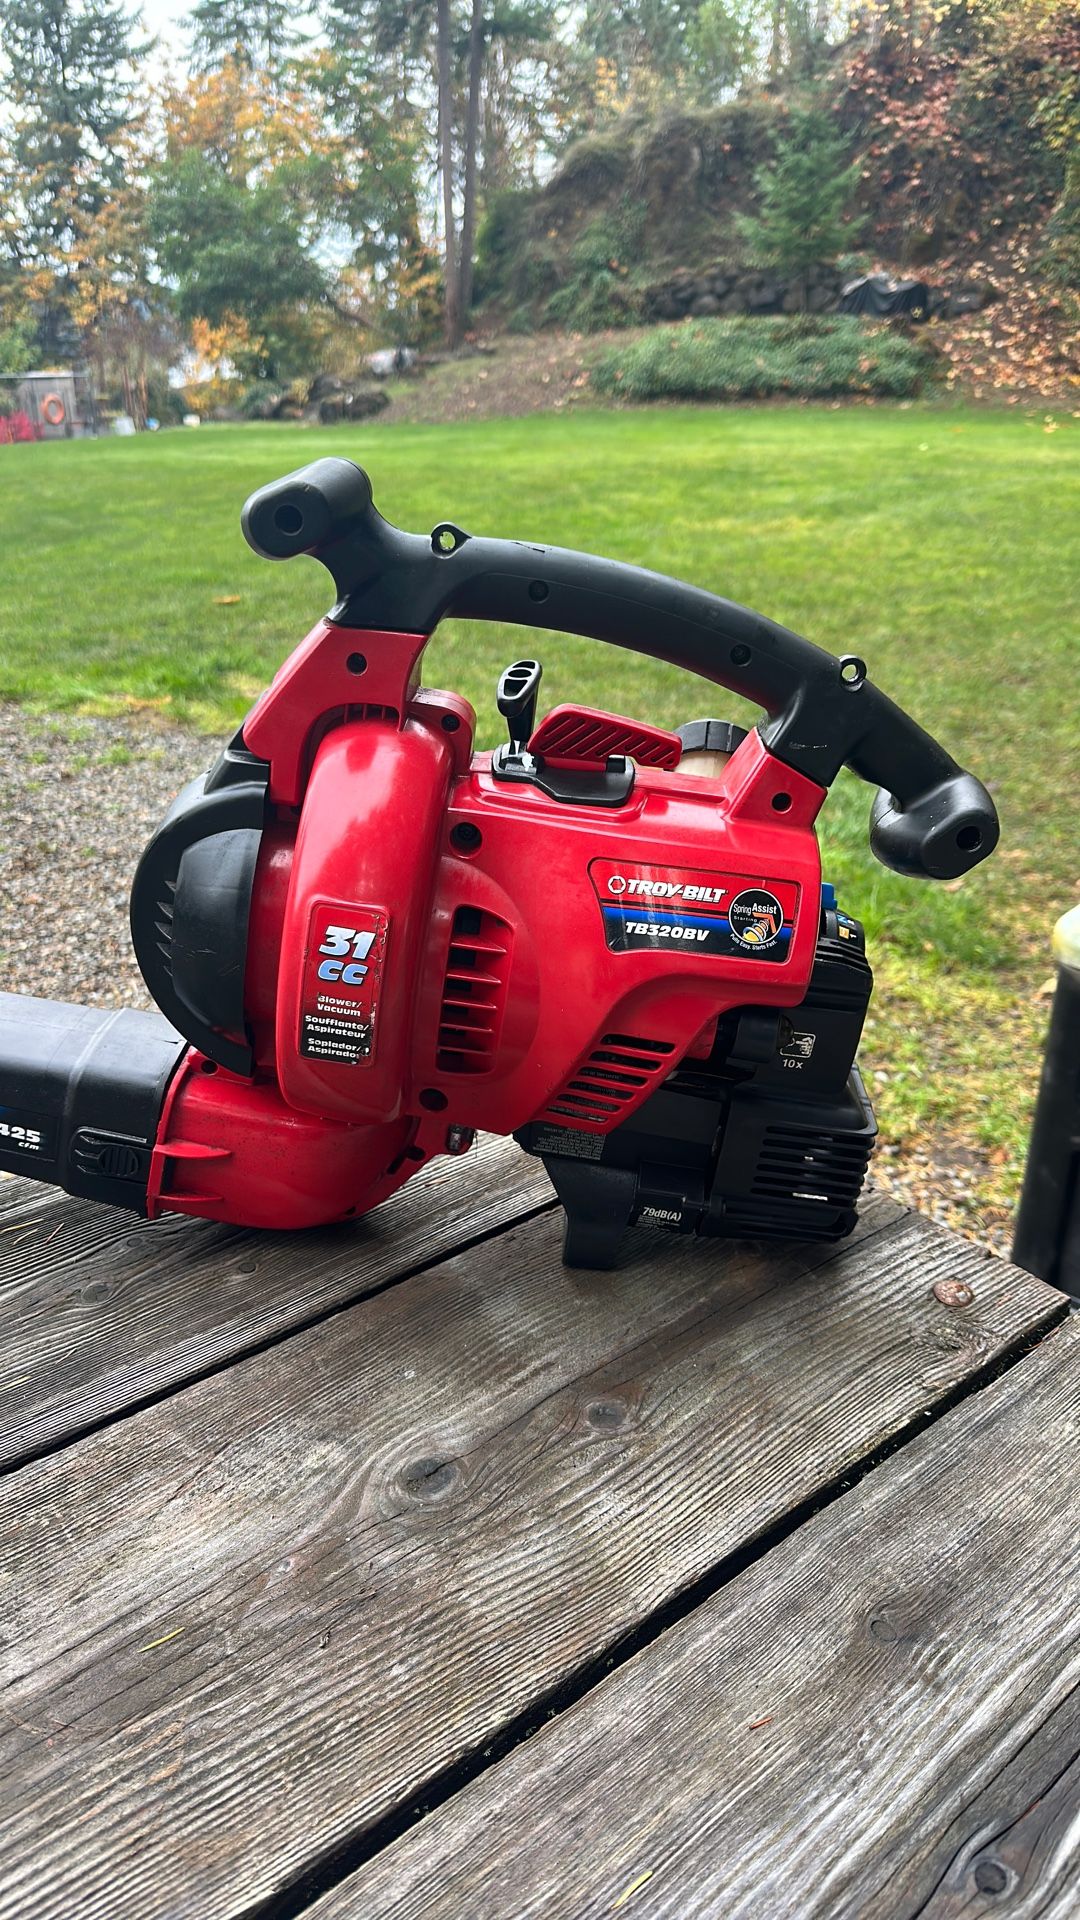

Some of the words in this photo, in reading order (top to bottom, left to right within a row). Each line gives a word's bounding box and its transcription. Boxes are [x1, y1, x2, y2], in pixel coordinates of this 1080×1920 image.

[627, 878, 726, 903] TROY-BILT
[733, 903, 752, 916] Spring
[751, 902, 777, 915] Assist
[625, 921, 710, 941] TB320BV
[319, 925, 376, 959] 31
[317, 1003, 361, 1017] Vacuum
[305, 1015, 370, 1031] Soufflante/
[306, 1024, 366, 1039] Aspirateur
[307, 1038, 362, 1052] Soplador/
[783, 1059, 804, 1068] 10x
[0, 1123, 40, 1143] 425
[18, 1142, 39, 1150] cfm
[642, 1206, 682, 1222] 79dB(A)
